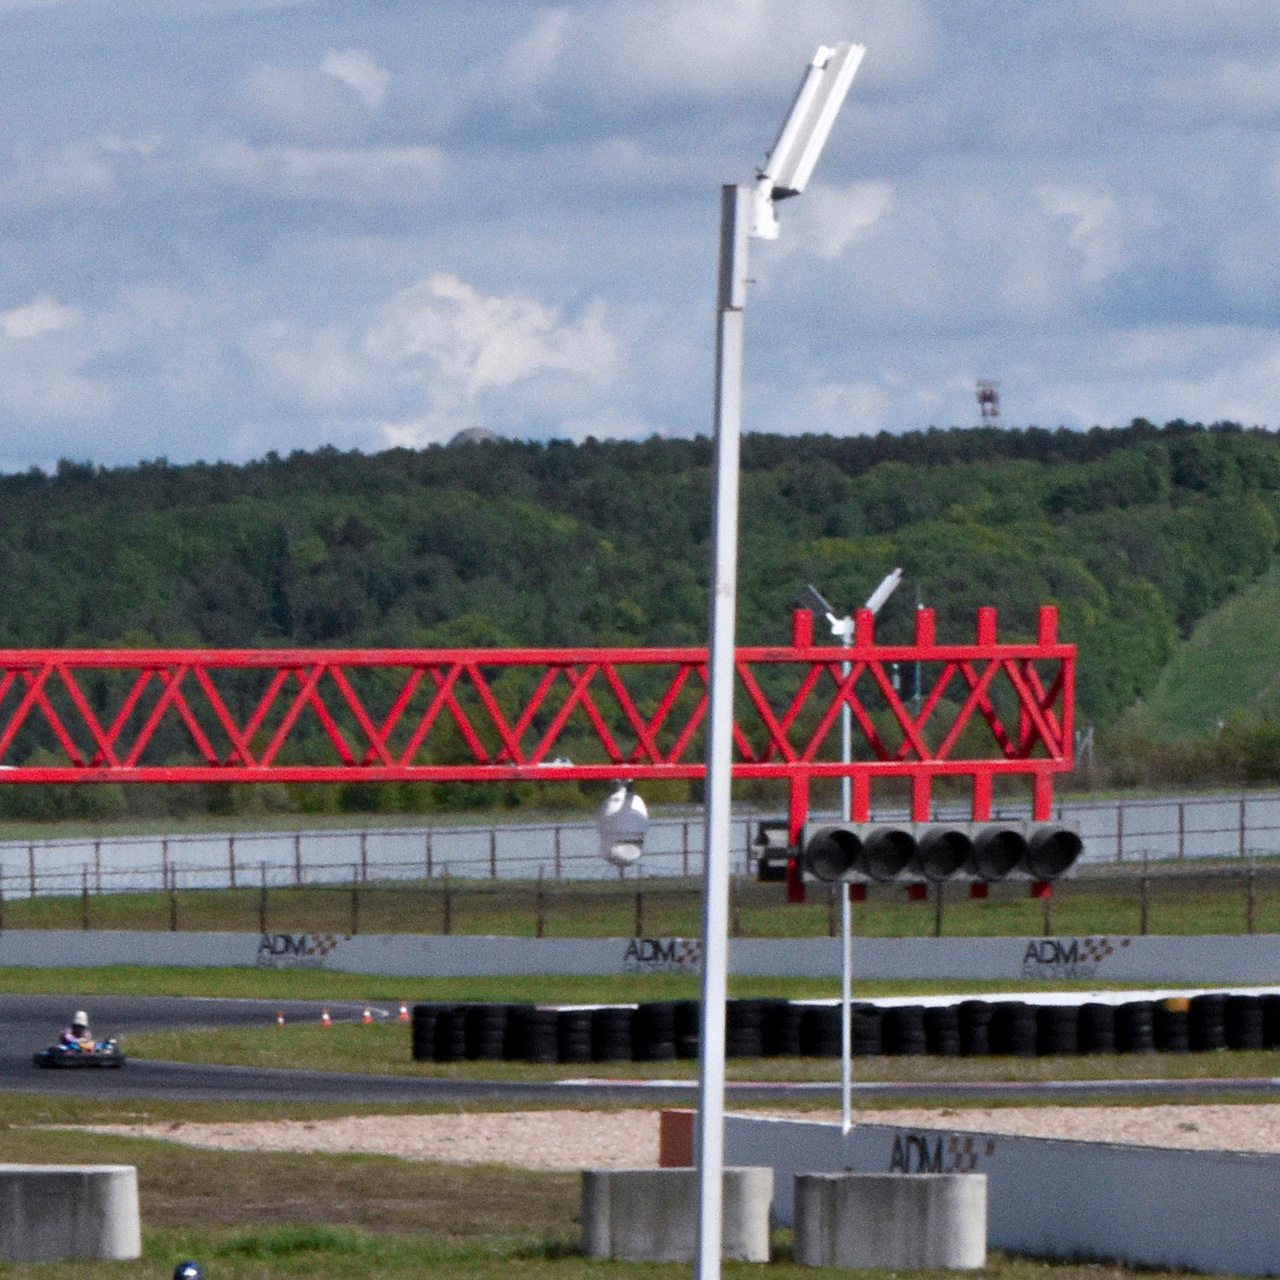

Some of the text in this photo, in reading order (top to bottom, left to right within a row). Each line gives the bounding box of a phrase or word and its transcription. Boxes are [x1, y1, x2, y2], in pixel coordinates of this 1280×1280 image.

[259, 934, 306, 955] ADM
[624, 939, 675, 961] ADM
[1023, 940, 1078, 963] ADM
[888, 1134, 943, 1173] ADM
